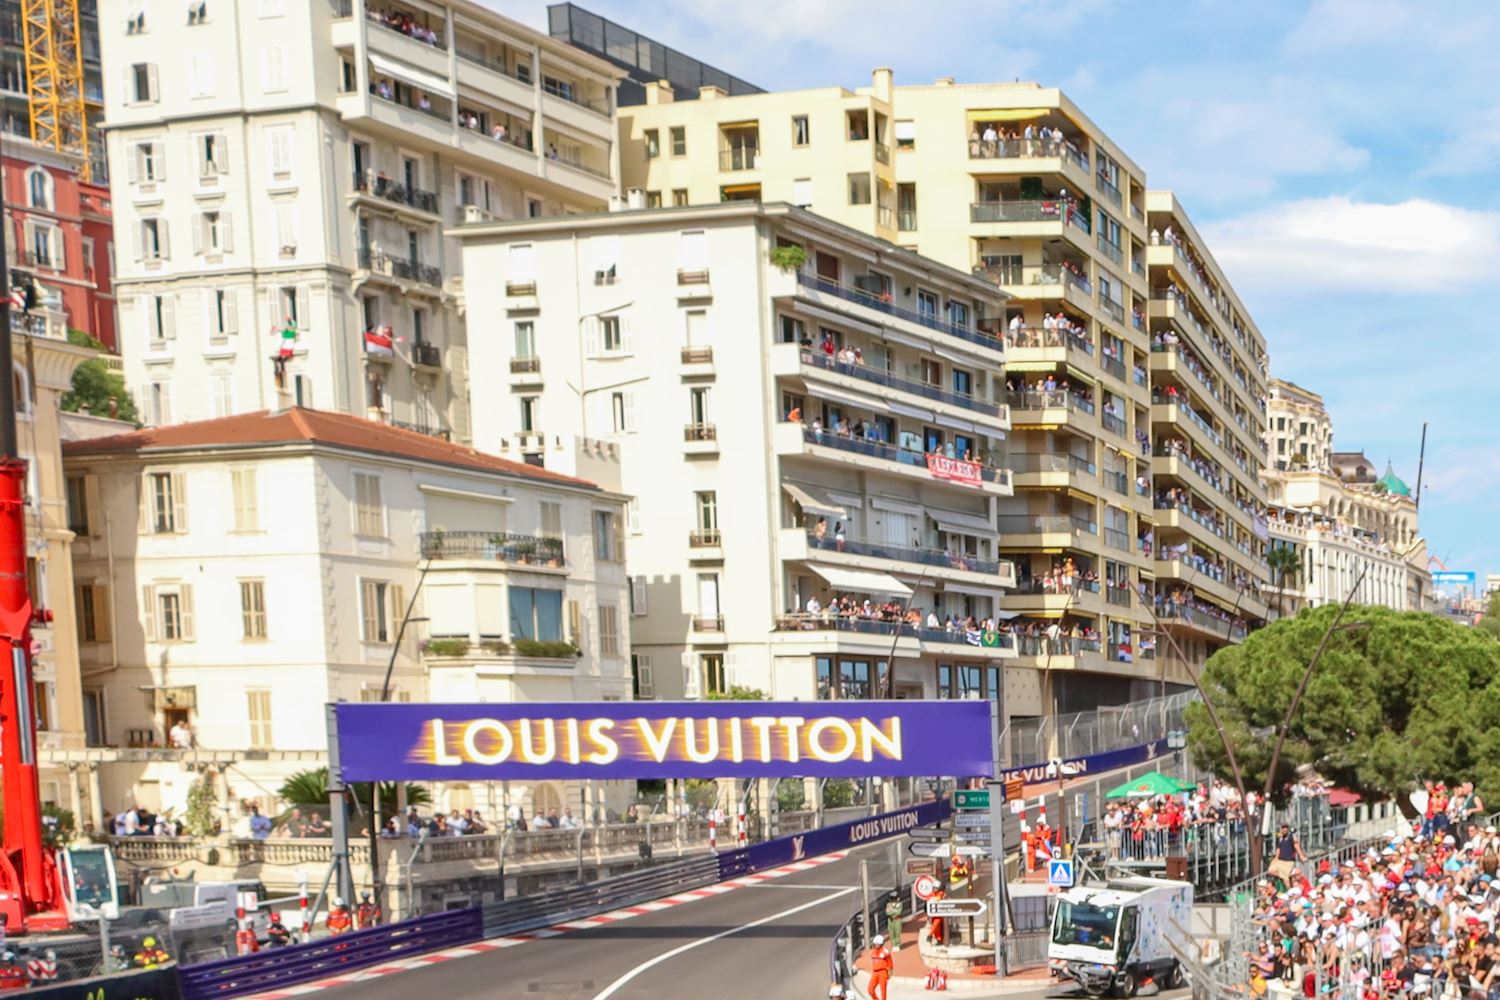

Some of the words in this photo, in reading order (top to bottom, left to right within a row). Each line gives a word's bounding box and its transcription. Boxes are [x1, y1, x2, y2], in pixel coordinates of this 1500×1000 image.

[432, 717, 619, 766] LOUIS
[637, 716, 902, 763] VUITTON
[850, 821, 880, 843] LOUIS
[880, 811, 919, 834] VUITTON
